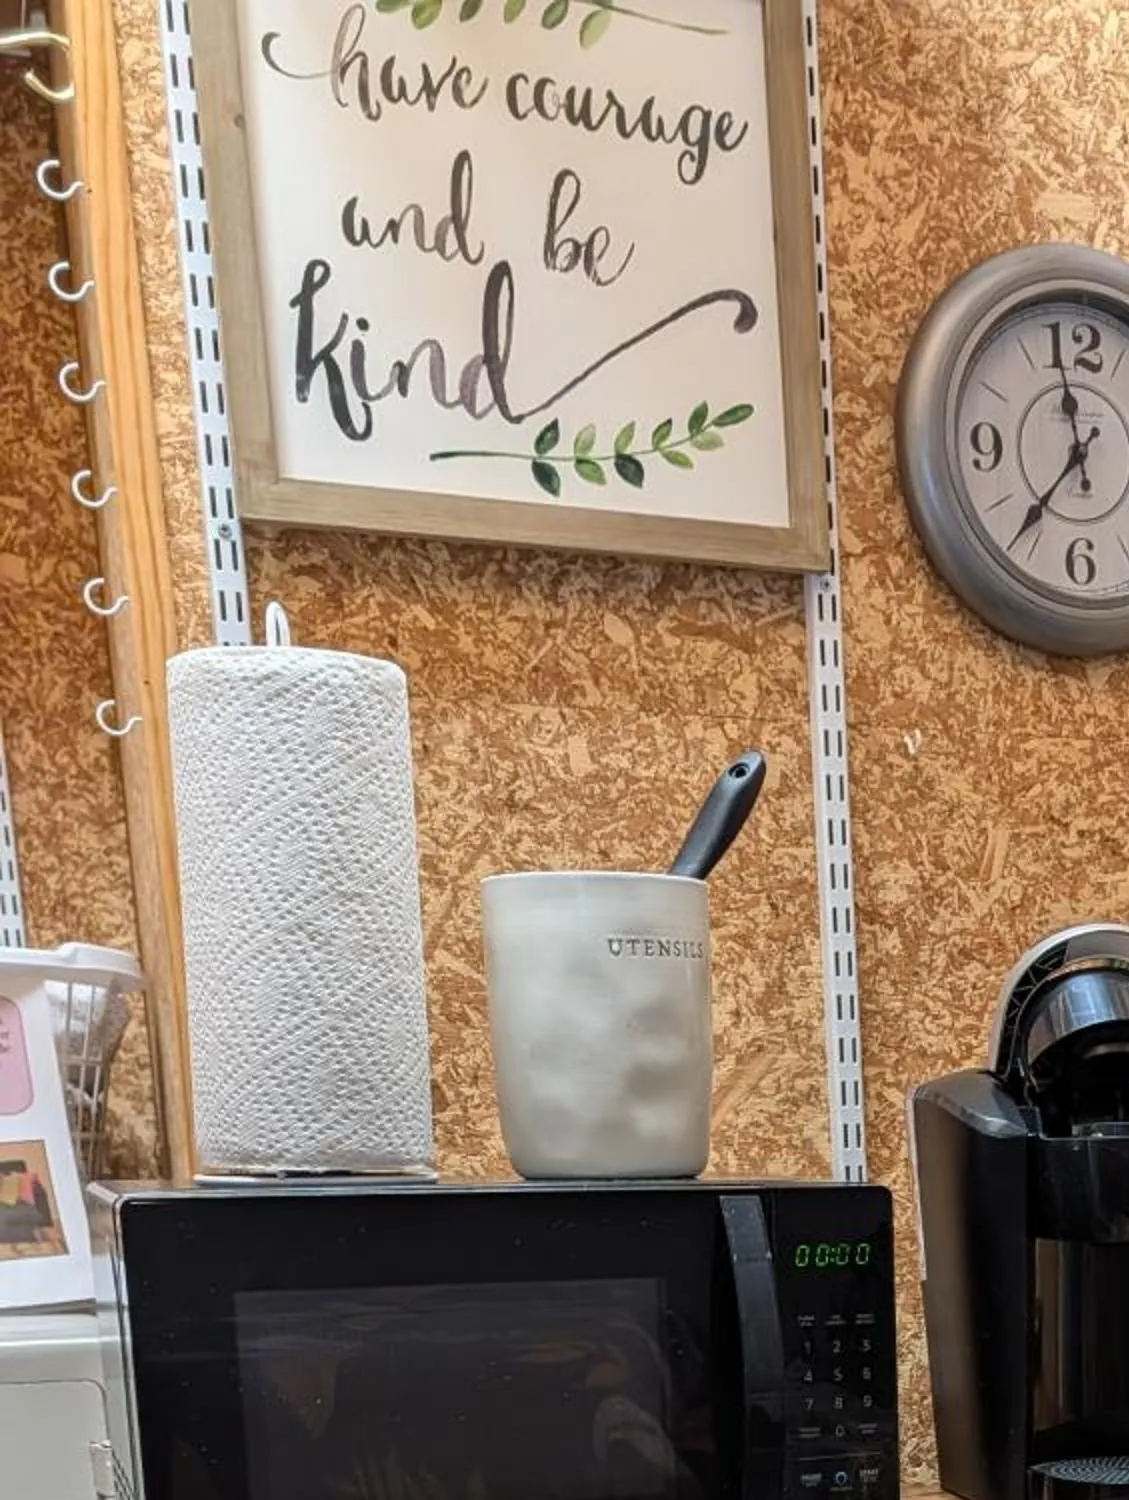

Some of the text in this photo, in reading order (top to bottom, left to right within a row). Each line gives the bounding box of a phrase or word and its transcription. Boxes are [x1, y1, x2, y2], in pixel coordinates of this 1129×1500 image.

[262, 4, 748, 185] have courage
[342, 150, 635, 286] and be
[1041, 321, 1103, 373] 12
[969, 422, 1003, 472] 9
[1065, 538, 1096, 586] 6
[607, 938, 704, 959] UTENSILS
[795, 1243, 870, 1267] 00:00
